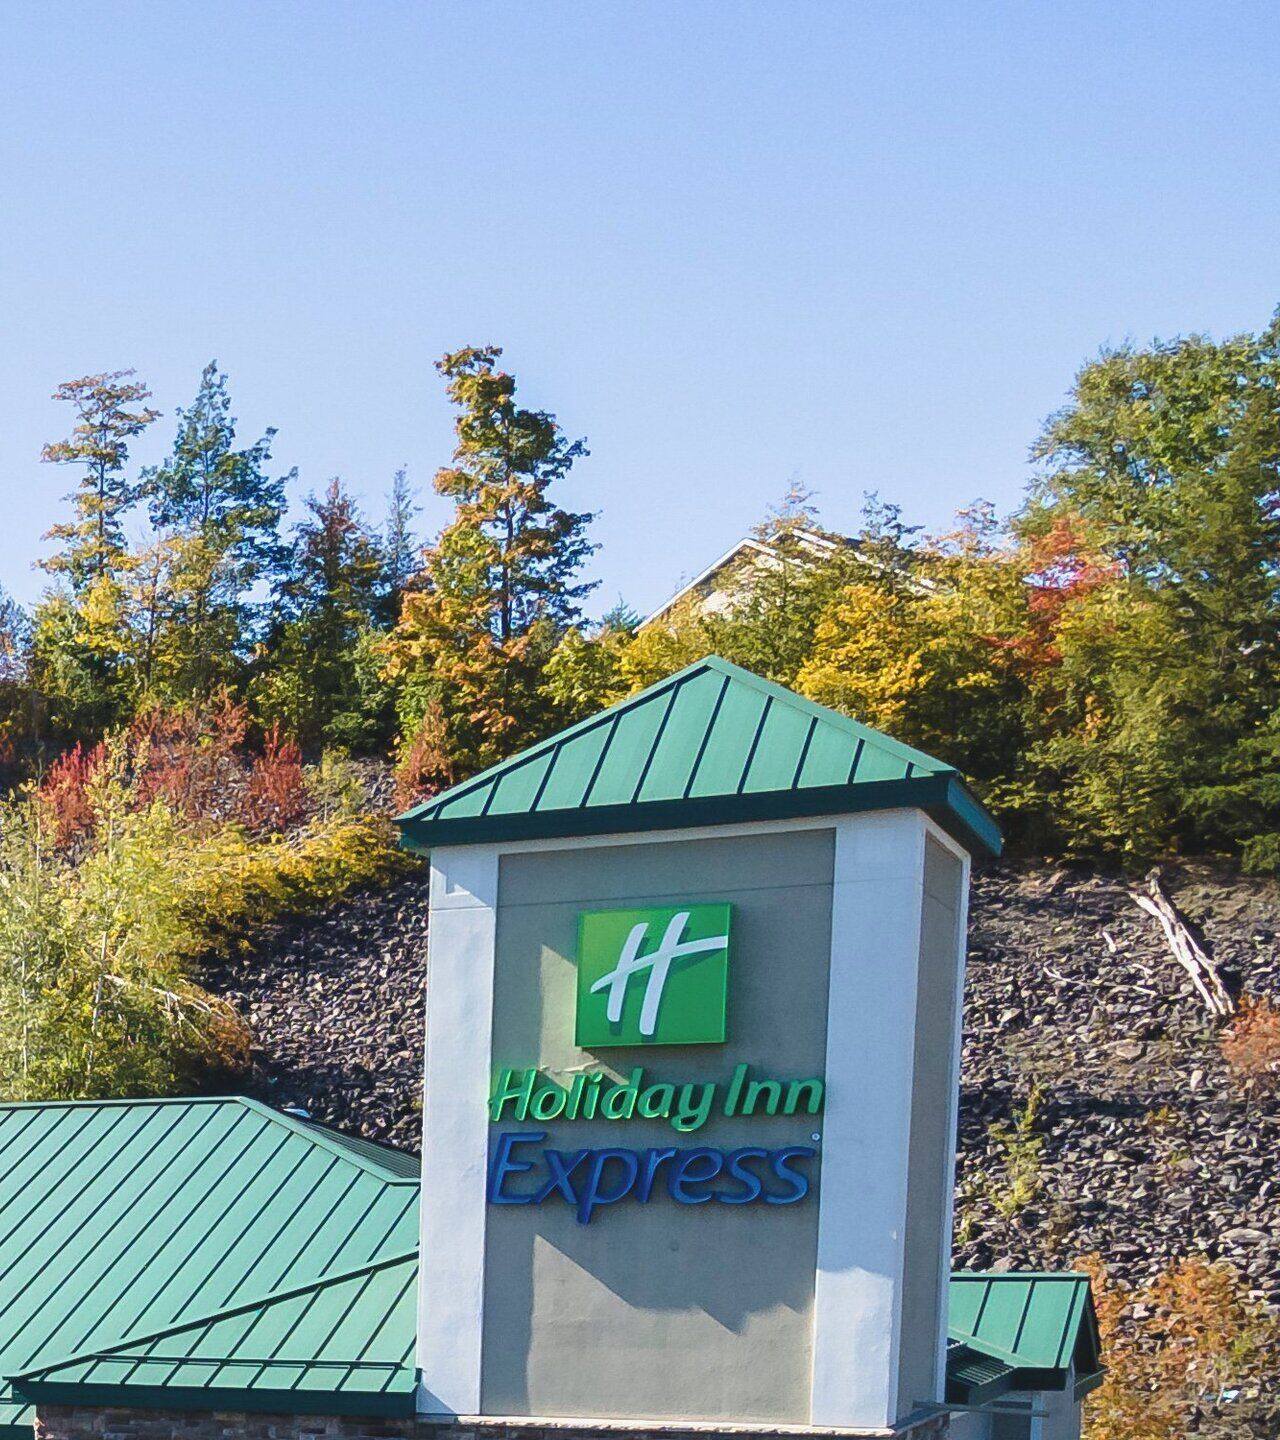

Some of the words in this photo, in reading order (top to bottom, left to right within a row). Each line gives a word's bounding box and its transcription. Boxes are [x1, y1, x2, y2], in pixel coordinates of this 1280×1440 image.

[590, 911, 728, 1035] H
[488, 1067, 716, 1132] Holiday
[723, 1063, 824, 1117] Inn
[489, 1131, 816, 1225] Express
